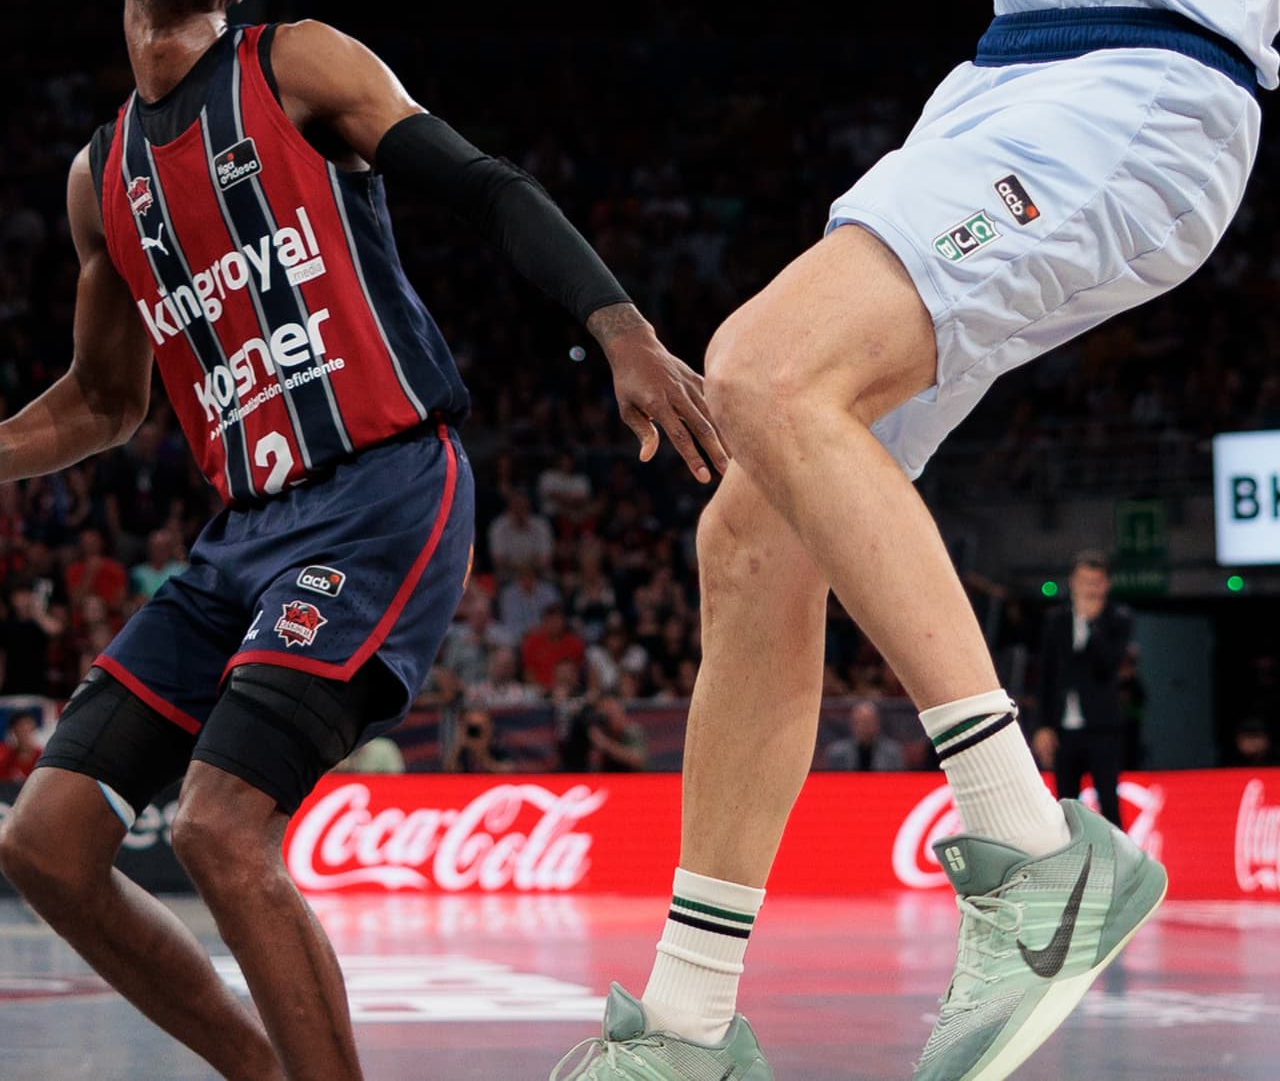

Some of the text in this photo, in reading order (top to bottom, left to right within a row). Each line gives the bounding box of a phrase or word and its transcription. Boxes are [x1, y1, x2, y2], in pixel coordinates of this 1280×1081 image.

[220, 160, 258, 184] endesa
[998, 181, 1024, 216] acb
[137, 206, 320, 345] kingroyal
[284, 357, 346, 390] eficiente
[302, 574, 330, 590] acb
